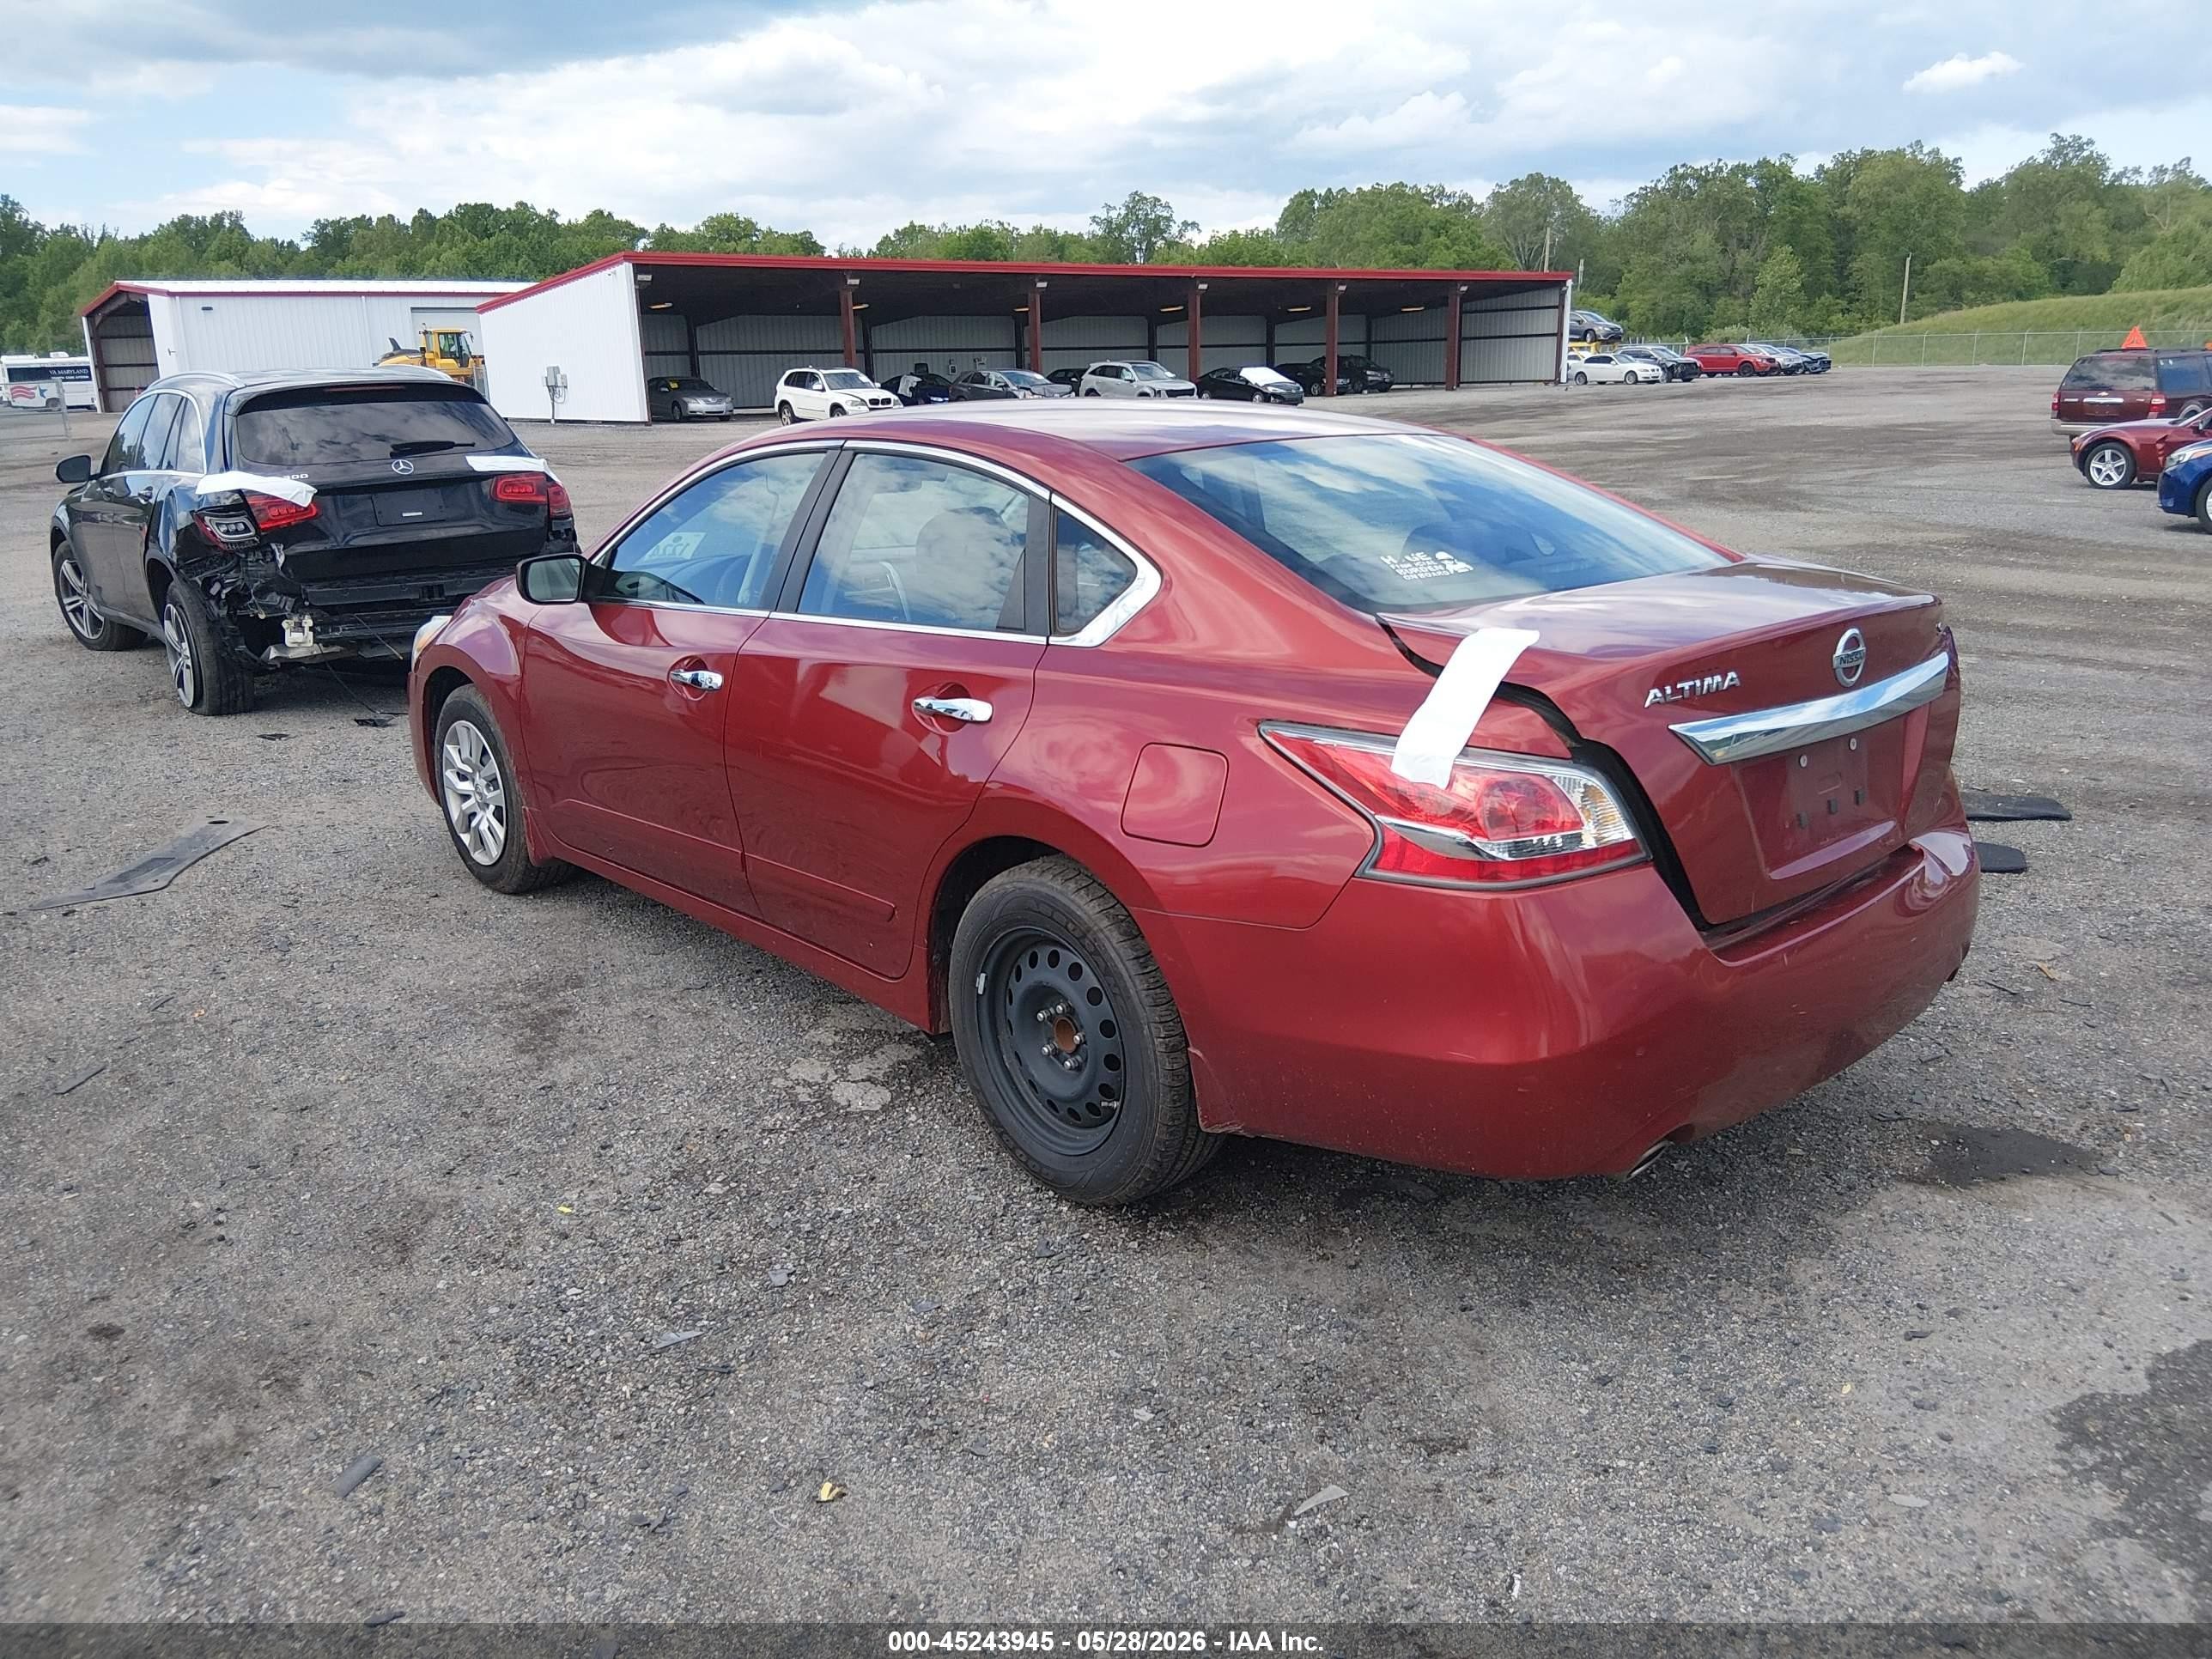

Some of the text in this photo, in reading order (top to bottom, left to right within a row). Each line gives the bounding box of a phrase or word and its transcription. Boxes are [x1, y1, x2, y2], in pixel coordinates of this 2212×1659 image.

[1380, 551, 1432, 565] HGE
[1395, 564, 1444, 575] BURDEN
[1418, 570, 1450, 579] BOARD
[1644, 671, 1741, 708] ALTIMA
